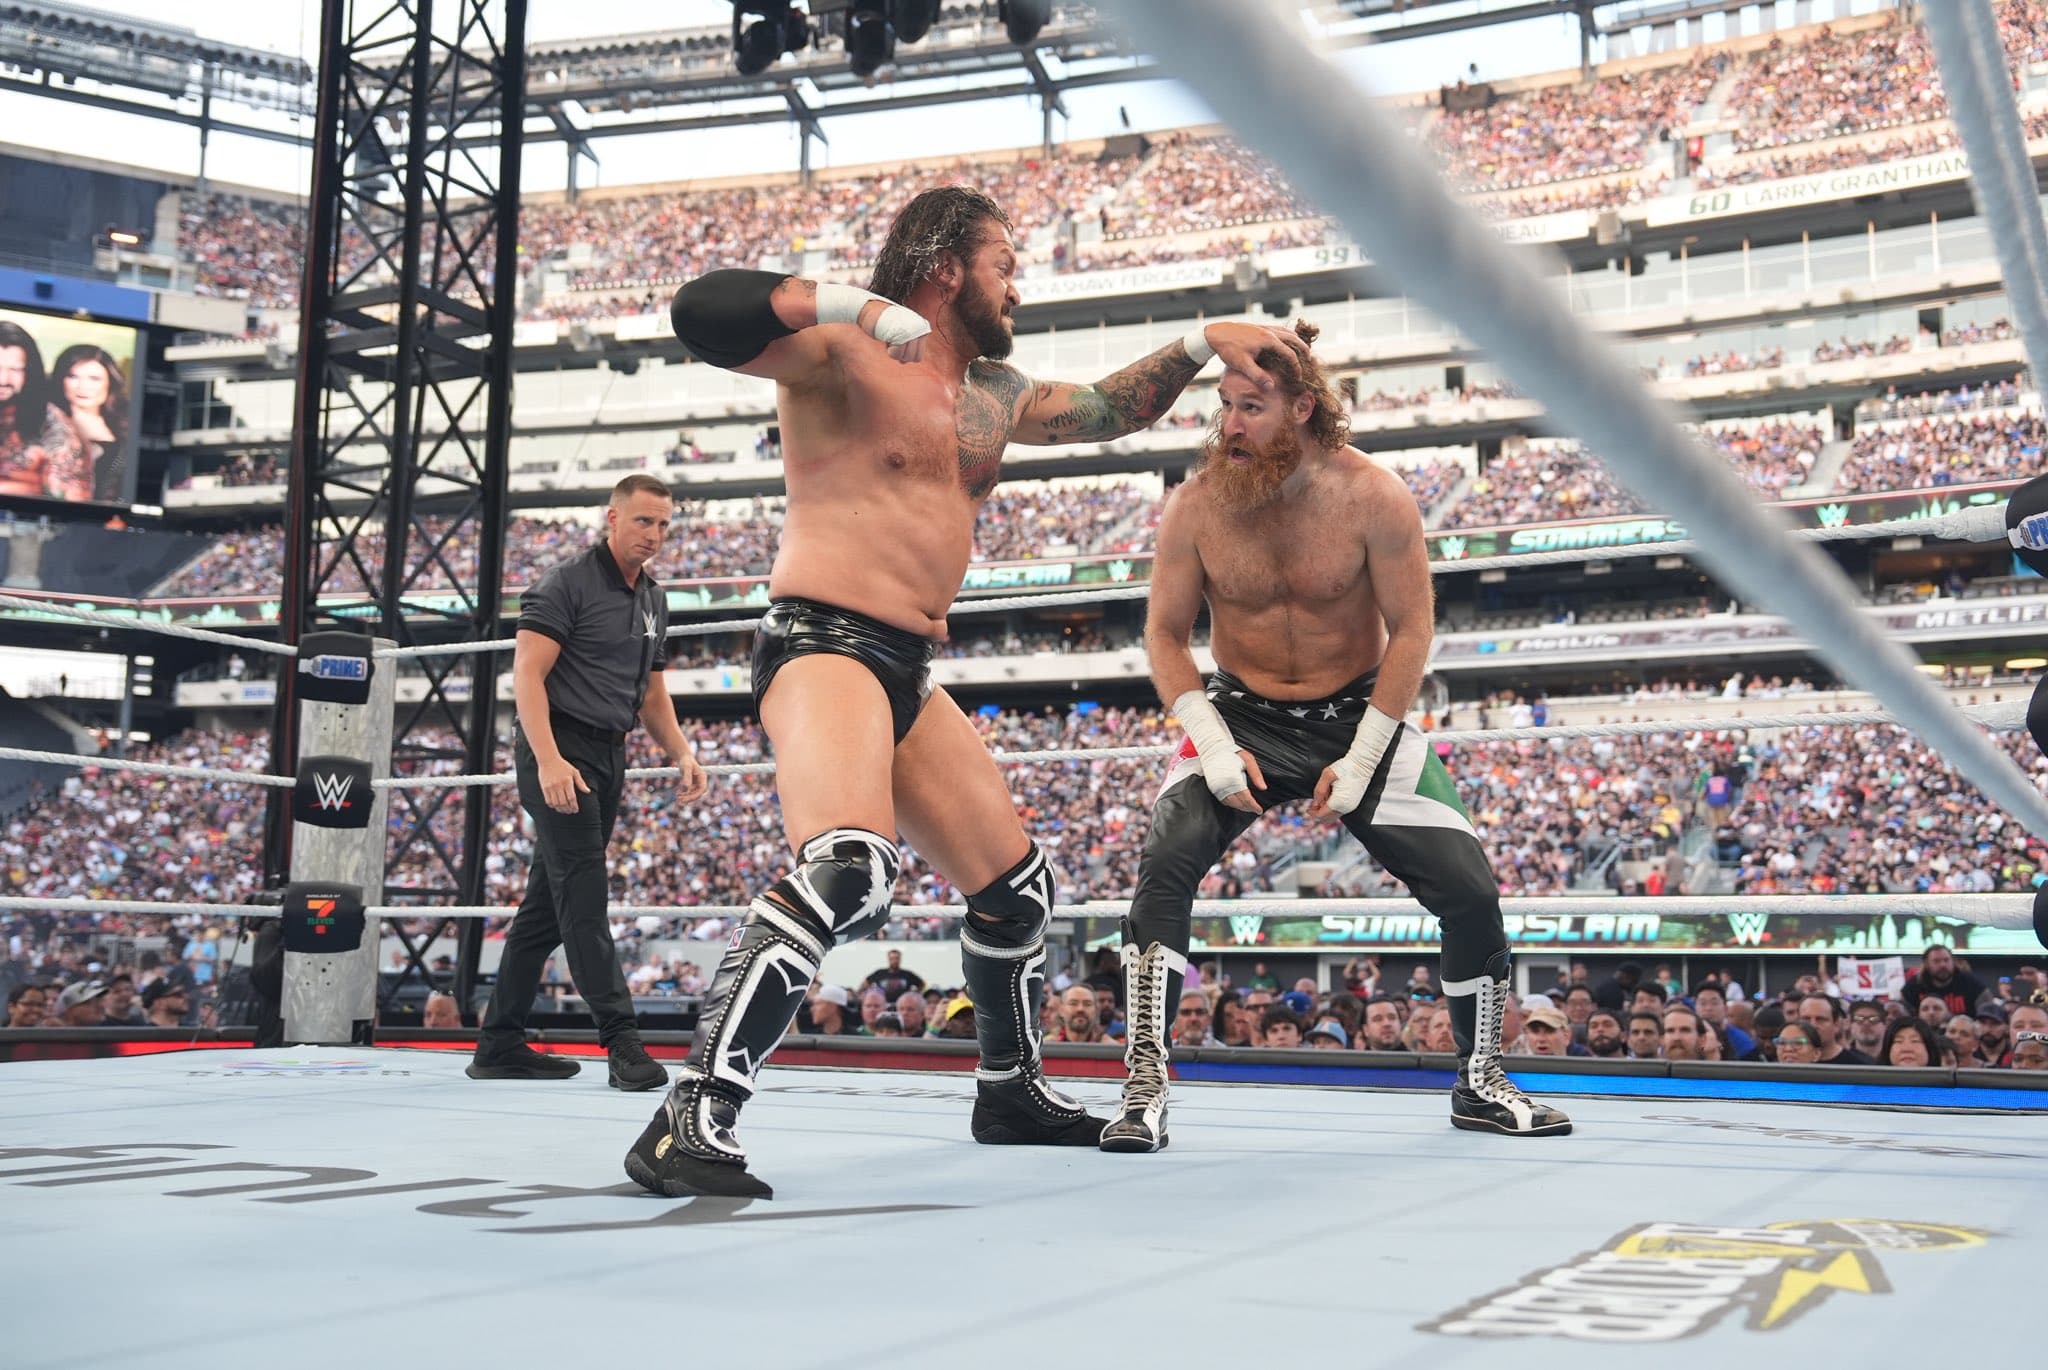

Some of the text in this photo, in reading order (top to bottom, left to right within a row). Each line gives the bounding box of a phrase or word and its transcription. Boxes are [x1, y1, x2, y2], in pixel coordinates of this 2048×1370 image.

[1689, 190, 1731, 215] 60
[1744, 180, 1822, 207] LARRY
[1314, 248, 1349, 266] 99
[1509, 520, 1688, 554] SUMMERS
[320, 658, 363, 677] PRIME
